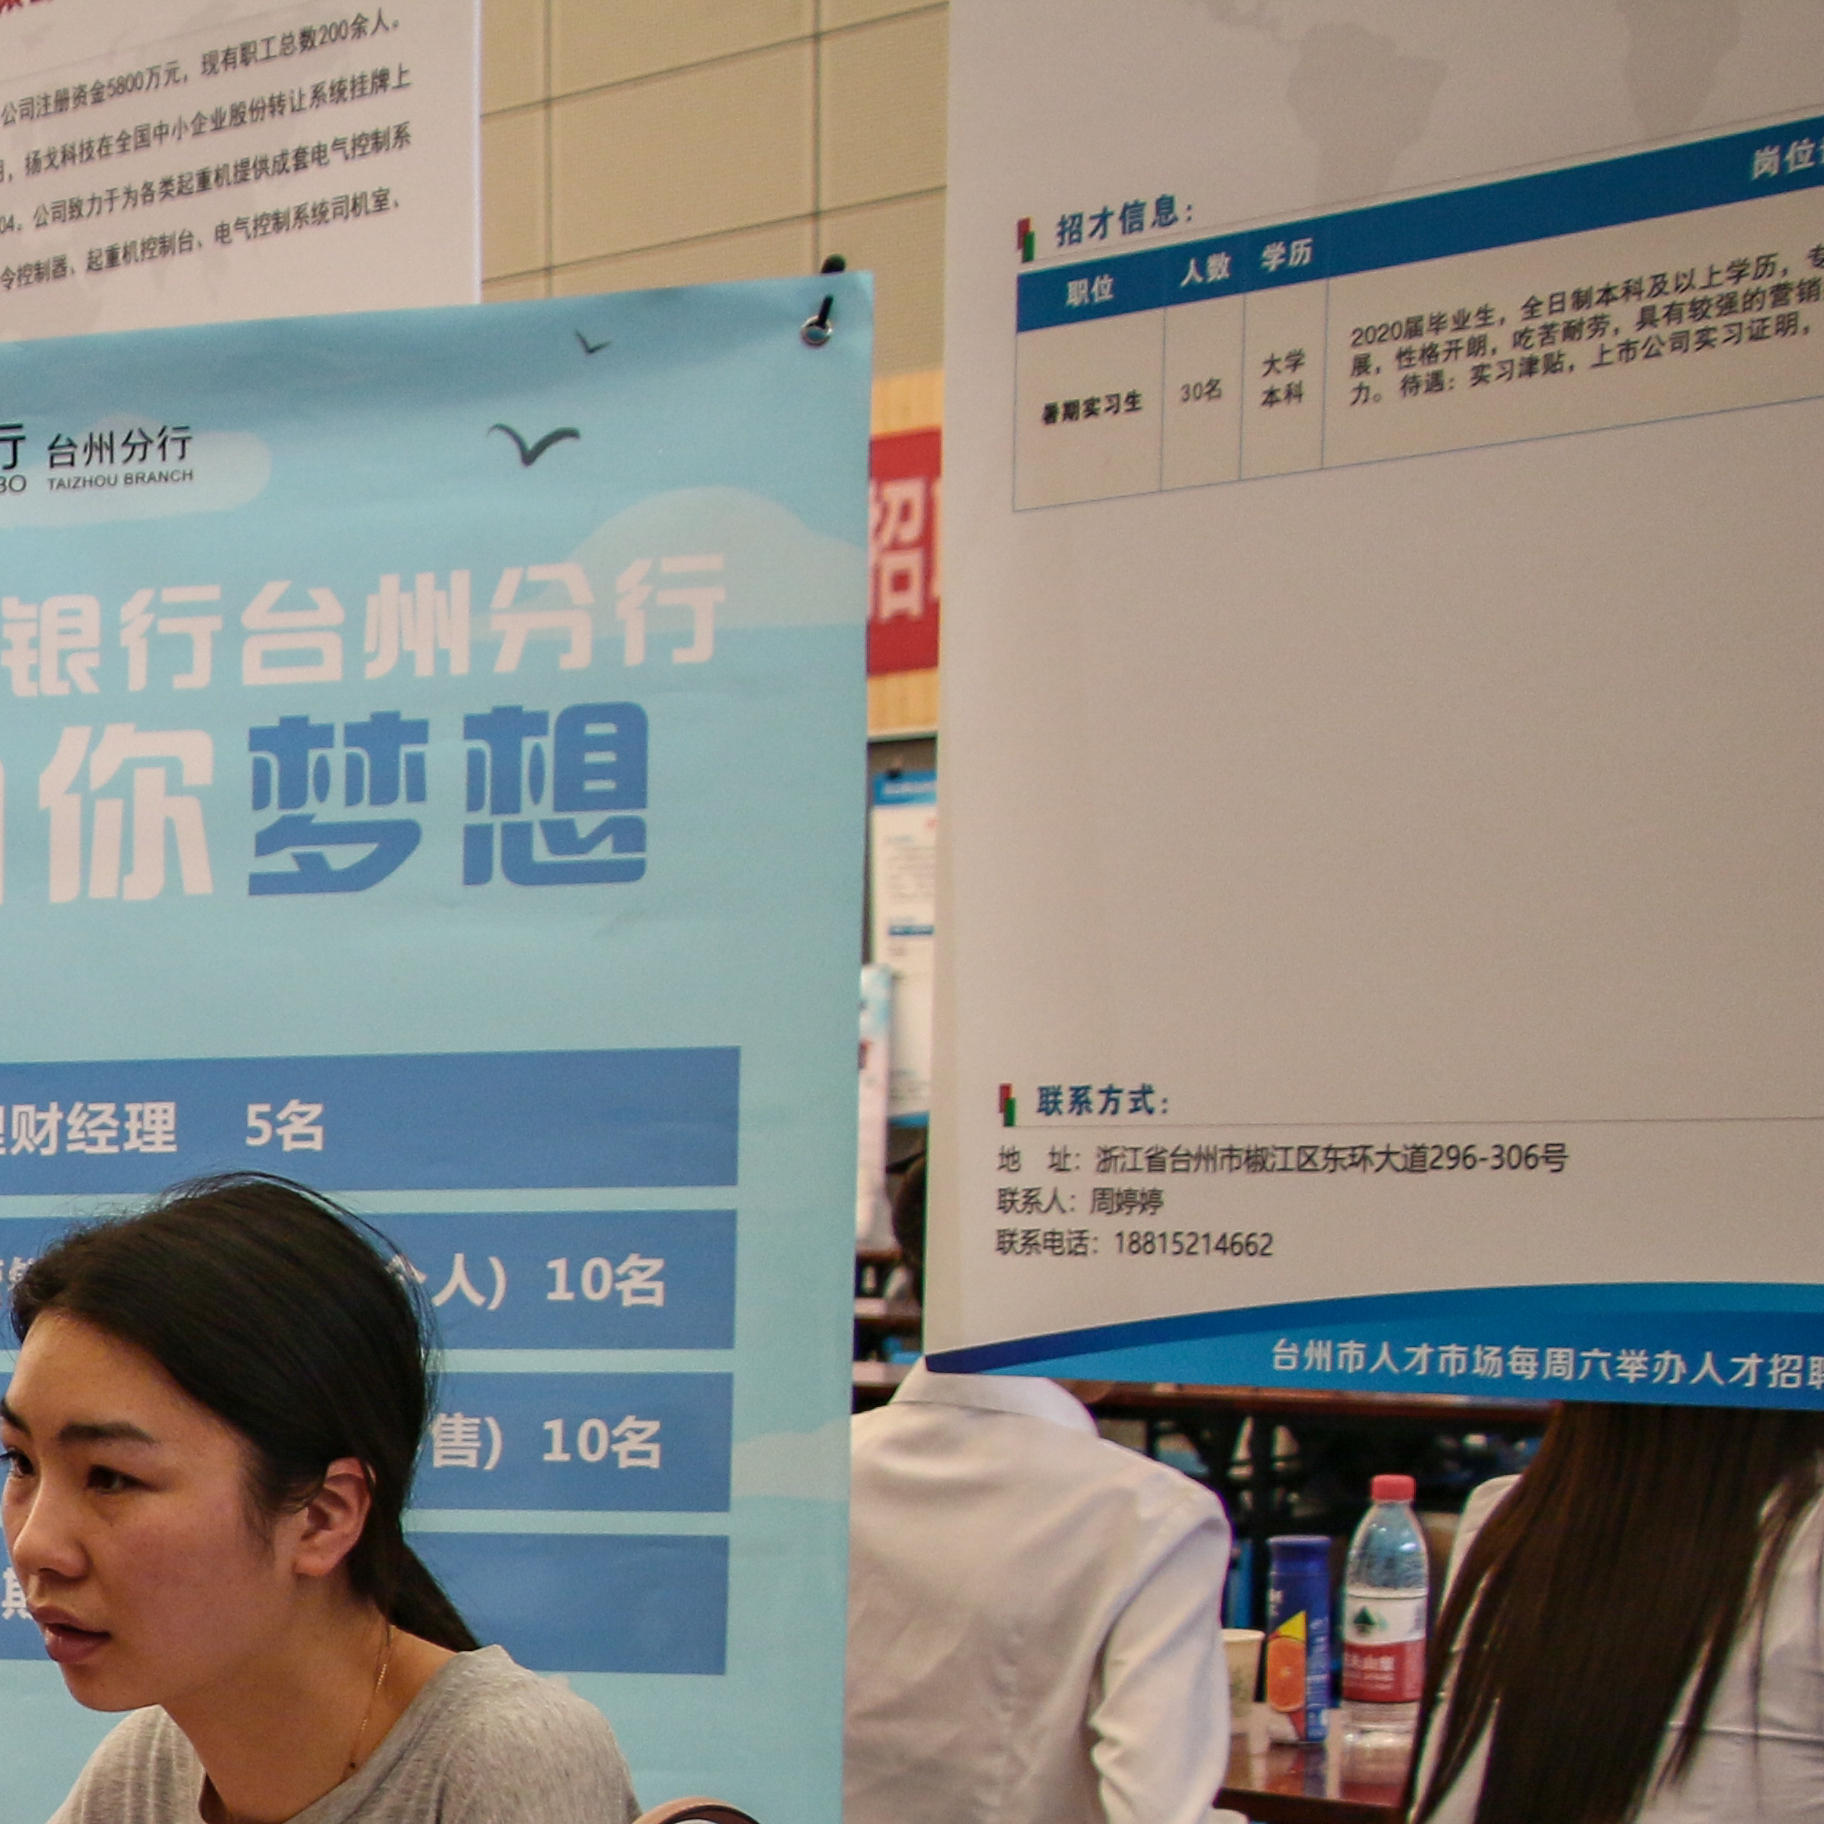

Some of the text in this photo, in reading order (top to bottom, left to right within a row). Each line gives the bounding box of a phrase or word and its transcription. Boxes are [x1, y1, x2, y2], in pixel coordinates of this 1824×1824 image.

[1753, 135, 1824, 180] 岗位
[1056, 194, 1193, 247] 招才信息：
[1065, 237, 1314, 306] 职位 人数 学历
[1261, 348, 1305, 377] 大学
[1042, 377, 1223, 425] 暑期实习生 30名
[1260, 380, 1304, 407] 本科
[47, 425, 192, 470] 台州分行
[47, 475, 118, 493] TAIZHOU
[123, 468, 194, 487] BRANCH
[1036, 1084, 1169, 1117] 联系方式：
[244, 1098, 326, 1151] 5名
[546, 1251, 667, 1308] 10名
[541, 1414, 663, 1469] 10名
